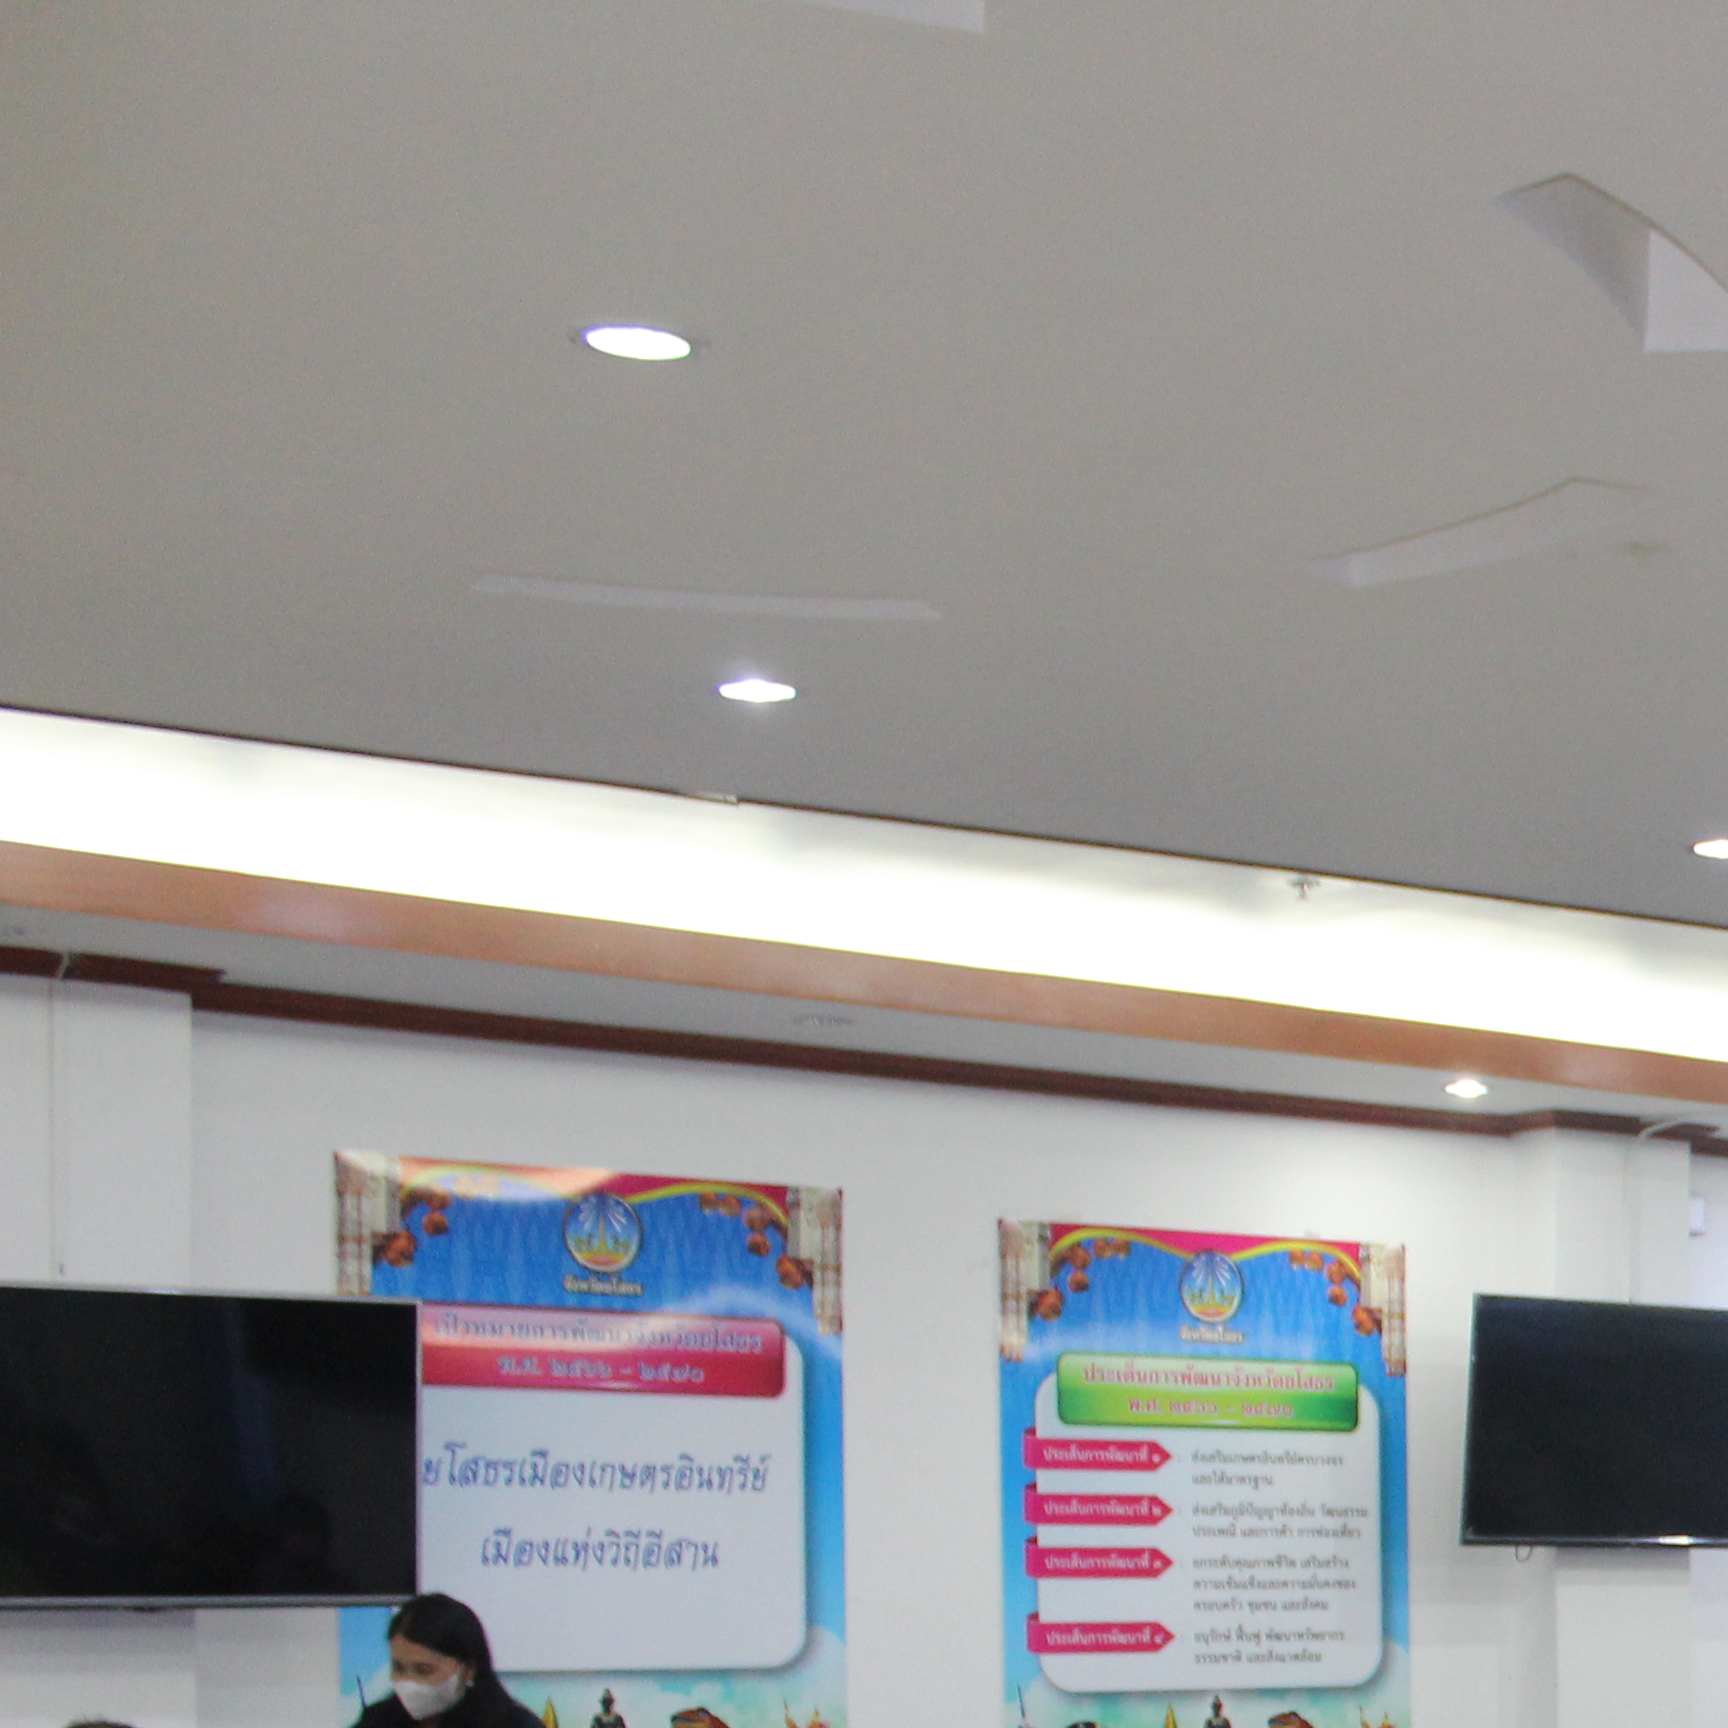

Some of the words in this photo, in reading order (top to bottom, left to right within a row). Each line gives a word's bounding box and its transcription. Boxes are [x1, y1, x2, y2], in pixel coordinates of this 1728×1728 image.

[422, 1441, 772, 1495] ยโสธรเมืองเกษตรอินทรีย์
[480, 1526, 719, 1571] เมืองแห่งวิถีอีสาน
